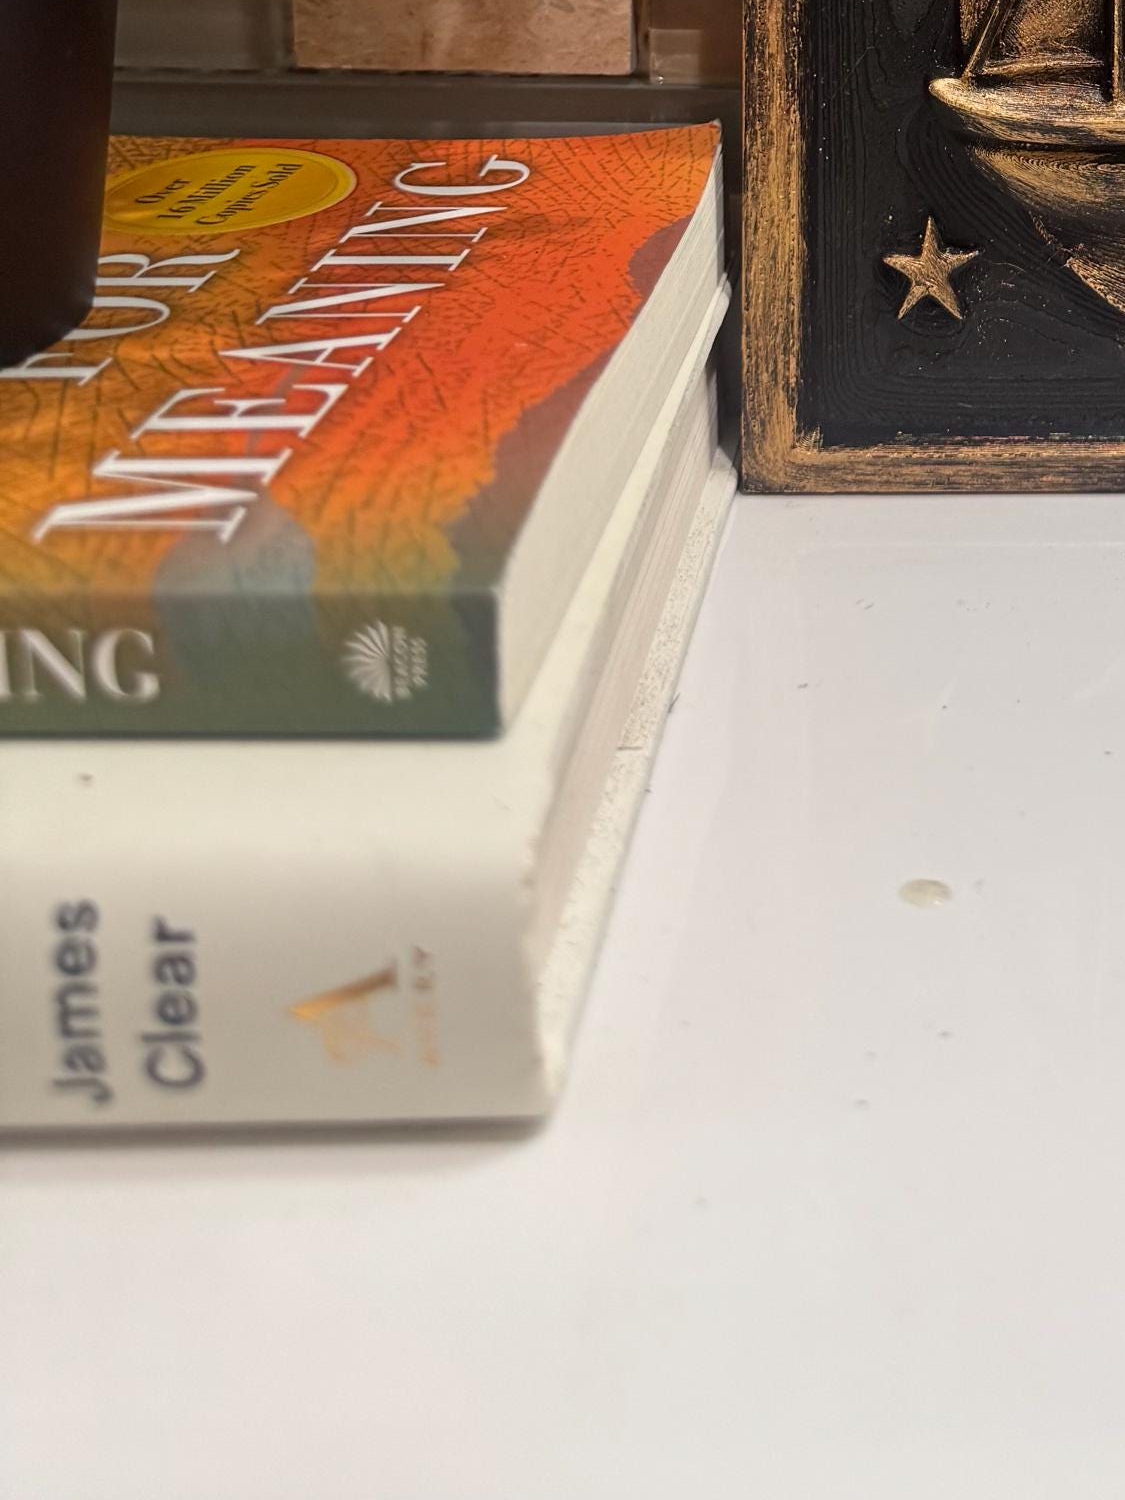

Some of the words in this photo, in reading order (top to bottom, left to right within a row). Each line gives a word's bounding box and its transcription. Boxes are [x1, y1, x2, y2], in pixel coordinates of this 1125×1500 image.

[134, 178, 190, 205] Over
[157, 204, 197, 219] 16
[177, 164, 256, 204] Million
[195, 189, 268, 225] Copies
[250, 163, 304, 189] Sold
[33, 153, 531, 544] MEANING
[51, 899, 113, 1106] James
[141, 915, 206, 1092] Clear
